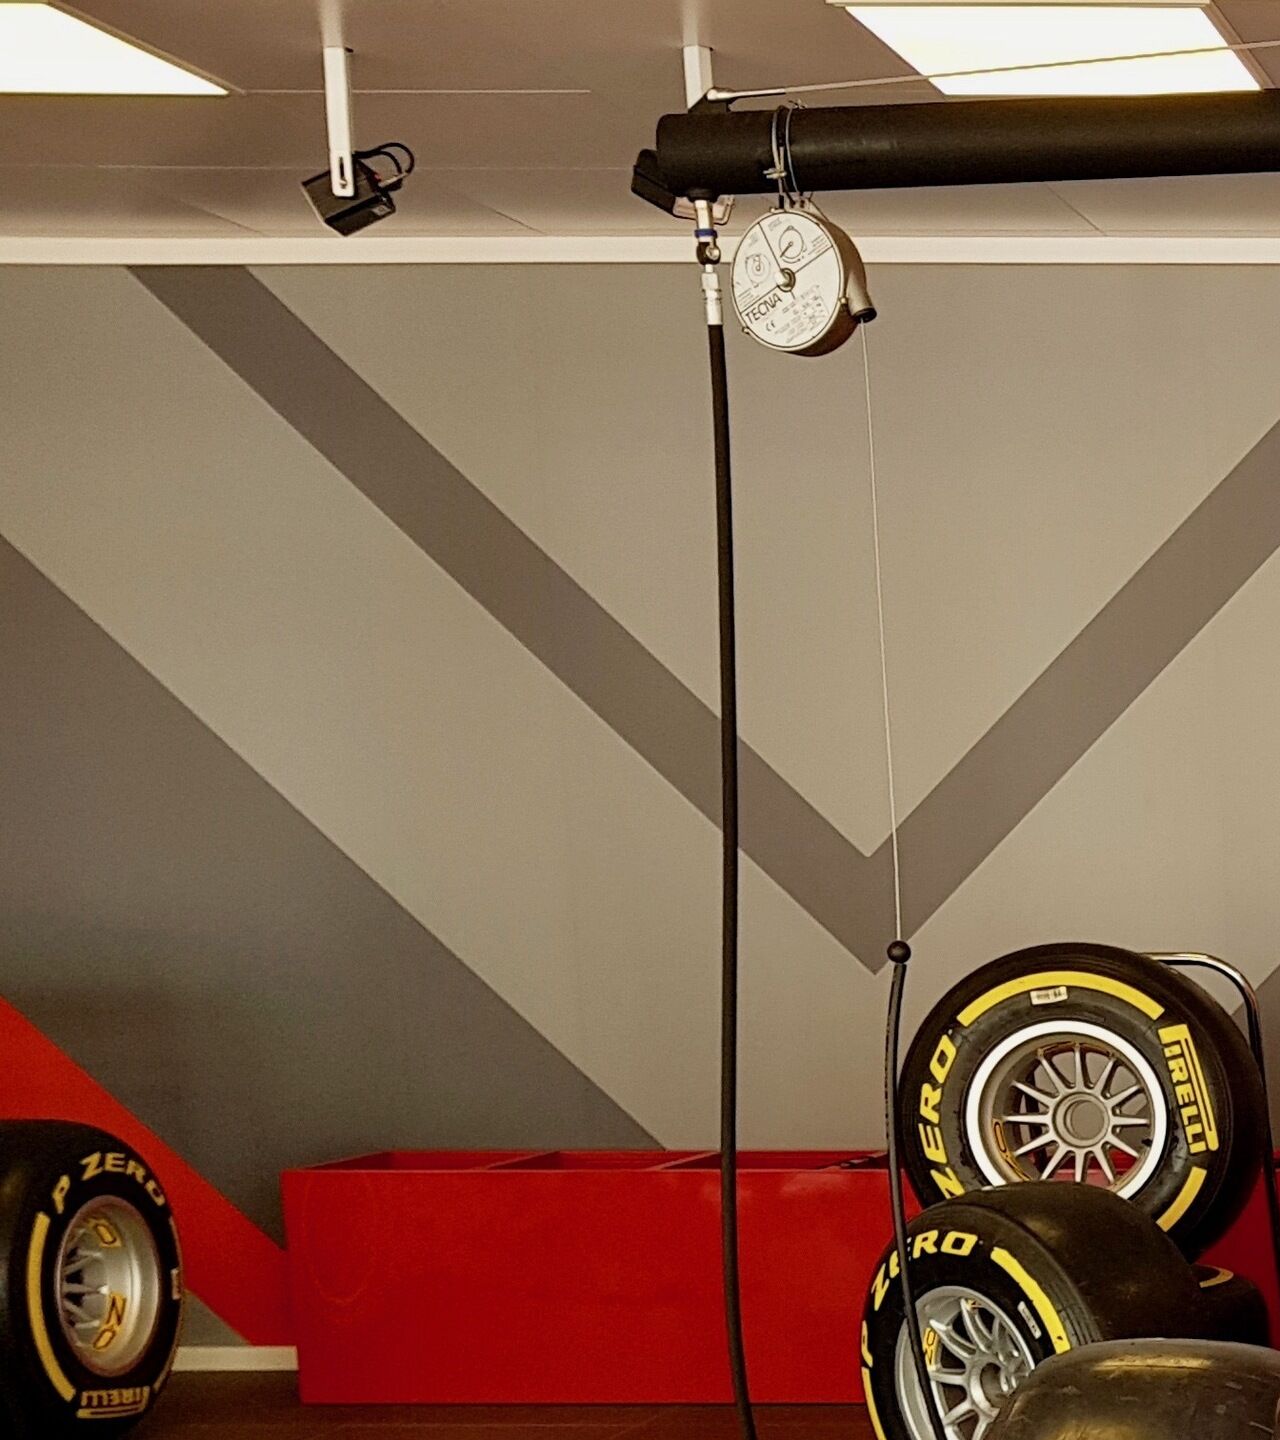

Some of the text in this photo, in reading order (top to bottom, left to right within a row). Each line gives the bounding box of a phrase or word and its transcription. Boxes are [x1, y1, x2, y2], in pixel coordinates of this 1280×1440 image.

[744, 292, 783, 324] TECNA
[918, 1033, 966, 1200] ZERO
[1156, 1023, 1219, 1154] PIRELLI
[52, 1150, 167, 1215] P ZERO
[75, 1386, 150, 1420] PIRELLI
